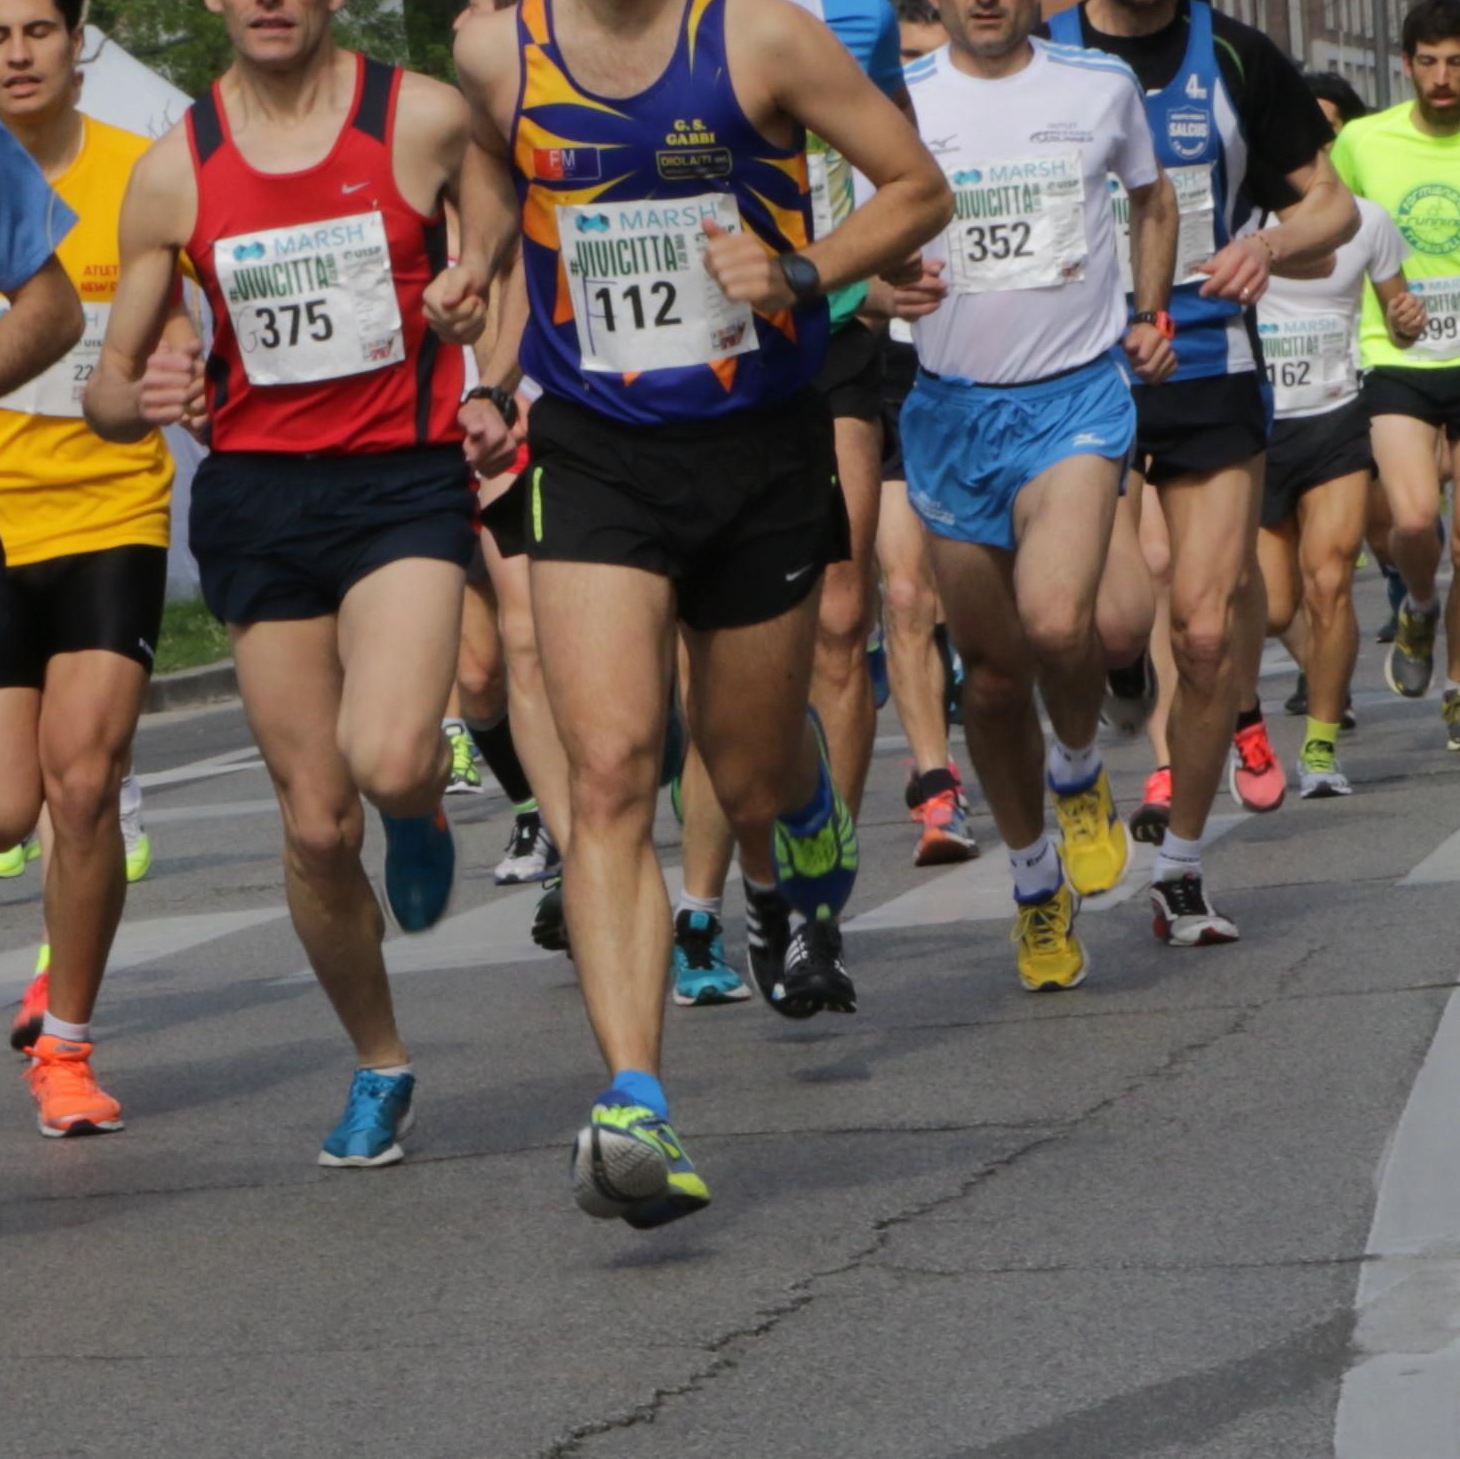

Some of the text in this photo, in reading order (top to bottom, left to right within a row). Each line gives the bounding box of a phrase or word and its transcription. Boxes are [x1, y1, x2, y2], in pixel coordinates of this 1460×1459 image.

[665, 132, 716, 146] GABBI
[989, 159, 1066, 182] MARSH
[619, 201, 718, 232] MARSH
[274, 222, 365, 255] MARSH
[966, 221, 1035, 263] 352
[83, 264, 119, 277] ATLET
[594, 280, 682, 333] 112
[255, 298, 334, 349] 375
[1266, 361, 1311, 388] 162
